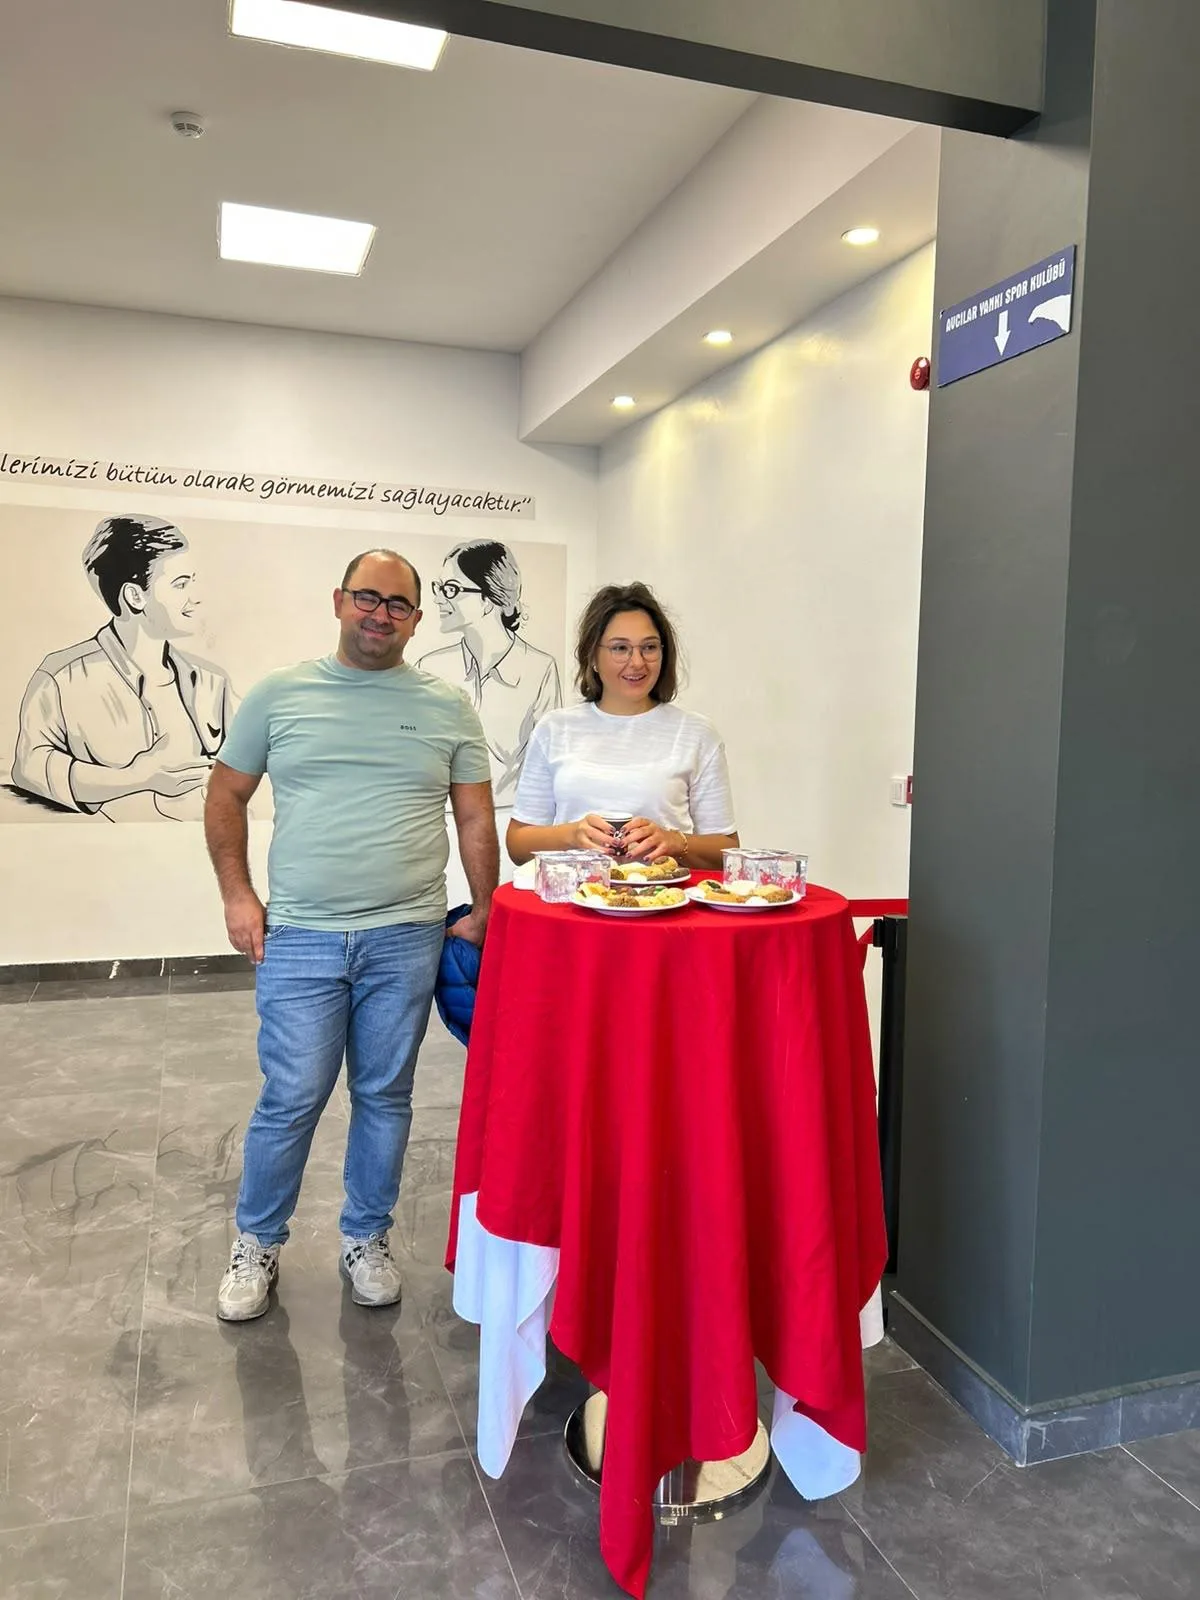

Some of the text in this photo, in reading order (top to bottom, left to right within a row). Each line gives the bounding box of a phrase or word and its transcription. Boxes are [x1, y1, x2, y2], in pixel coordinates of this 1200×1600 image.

[945, 258, 1066, 333] AVCILAR YANKI SPOR KULÜBÜ
[106, 462, 178, 485] bütün
[183, 470, 255, 493] olarak
[259, 477, 377, 500] görmemizi
